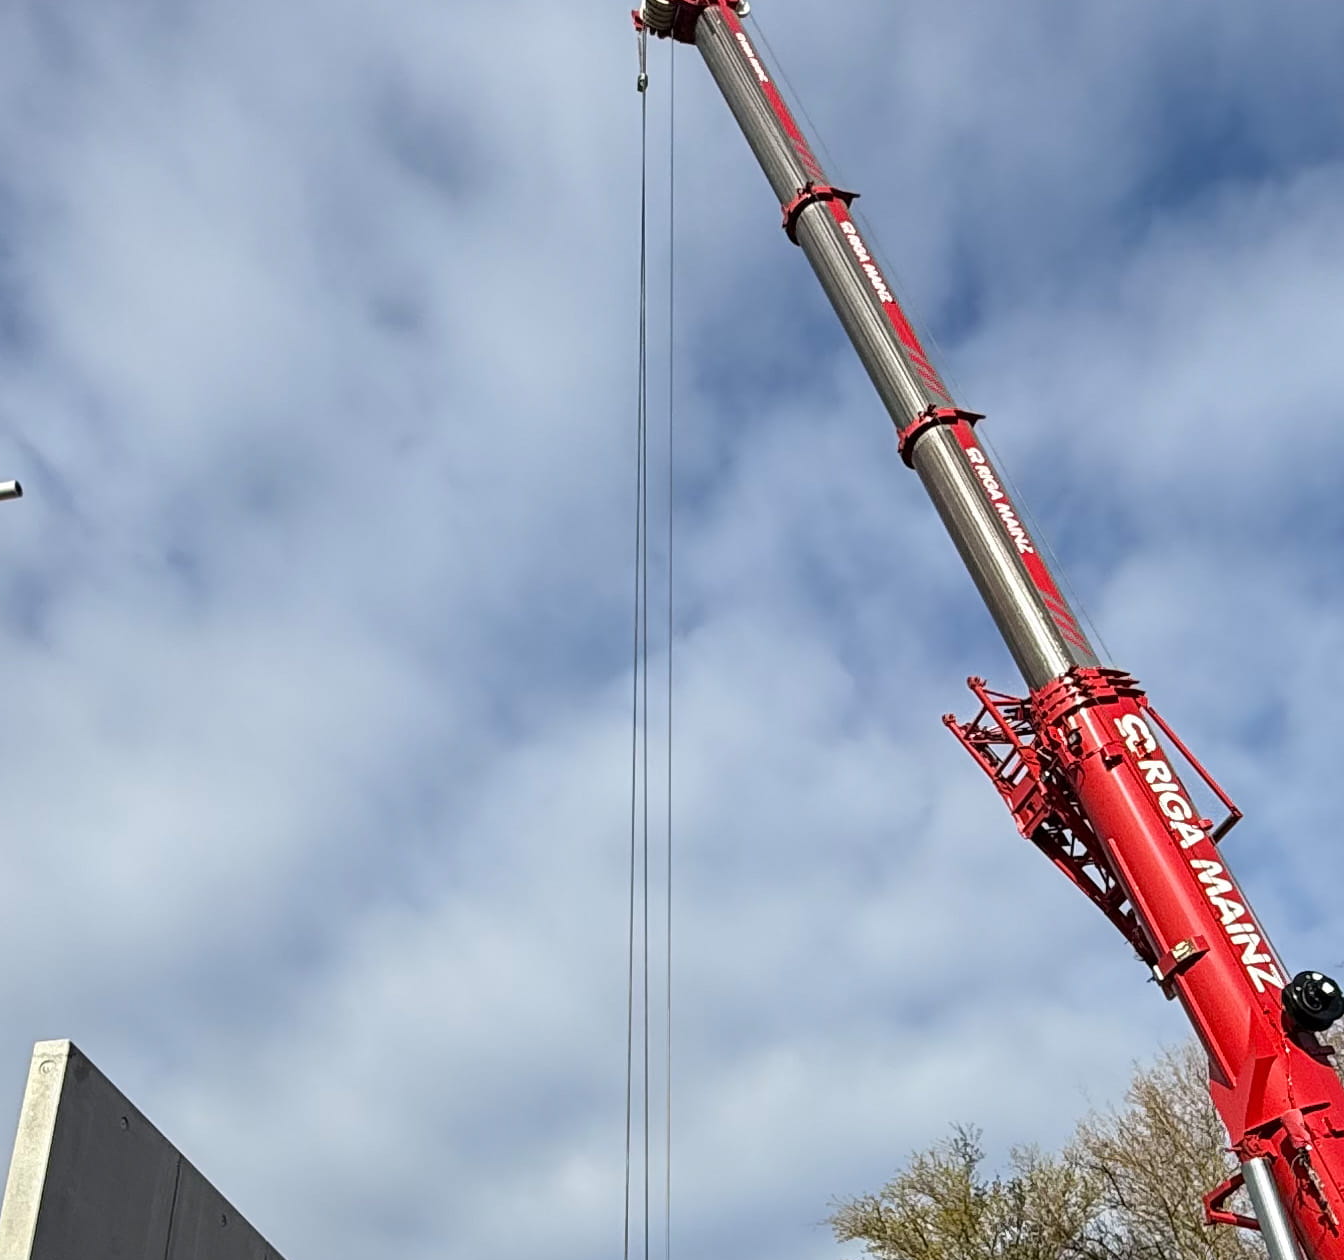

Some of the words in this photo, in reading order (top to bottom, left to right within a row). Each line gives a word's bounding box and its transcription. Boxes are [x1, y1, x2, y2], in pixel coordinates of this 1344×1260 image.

[975, 465, 1004, 501] RIGA
[995, 502, 1034, 554] MAINZ
[1137, 759, 1205, 849] RIGA
[1190, 858, 1285, 993] MAINZ
